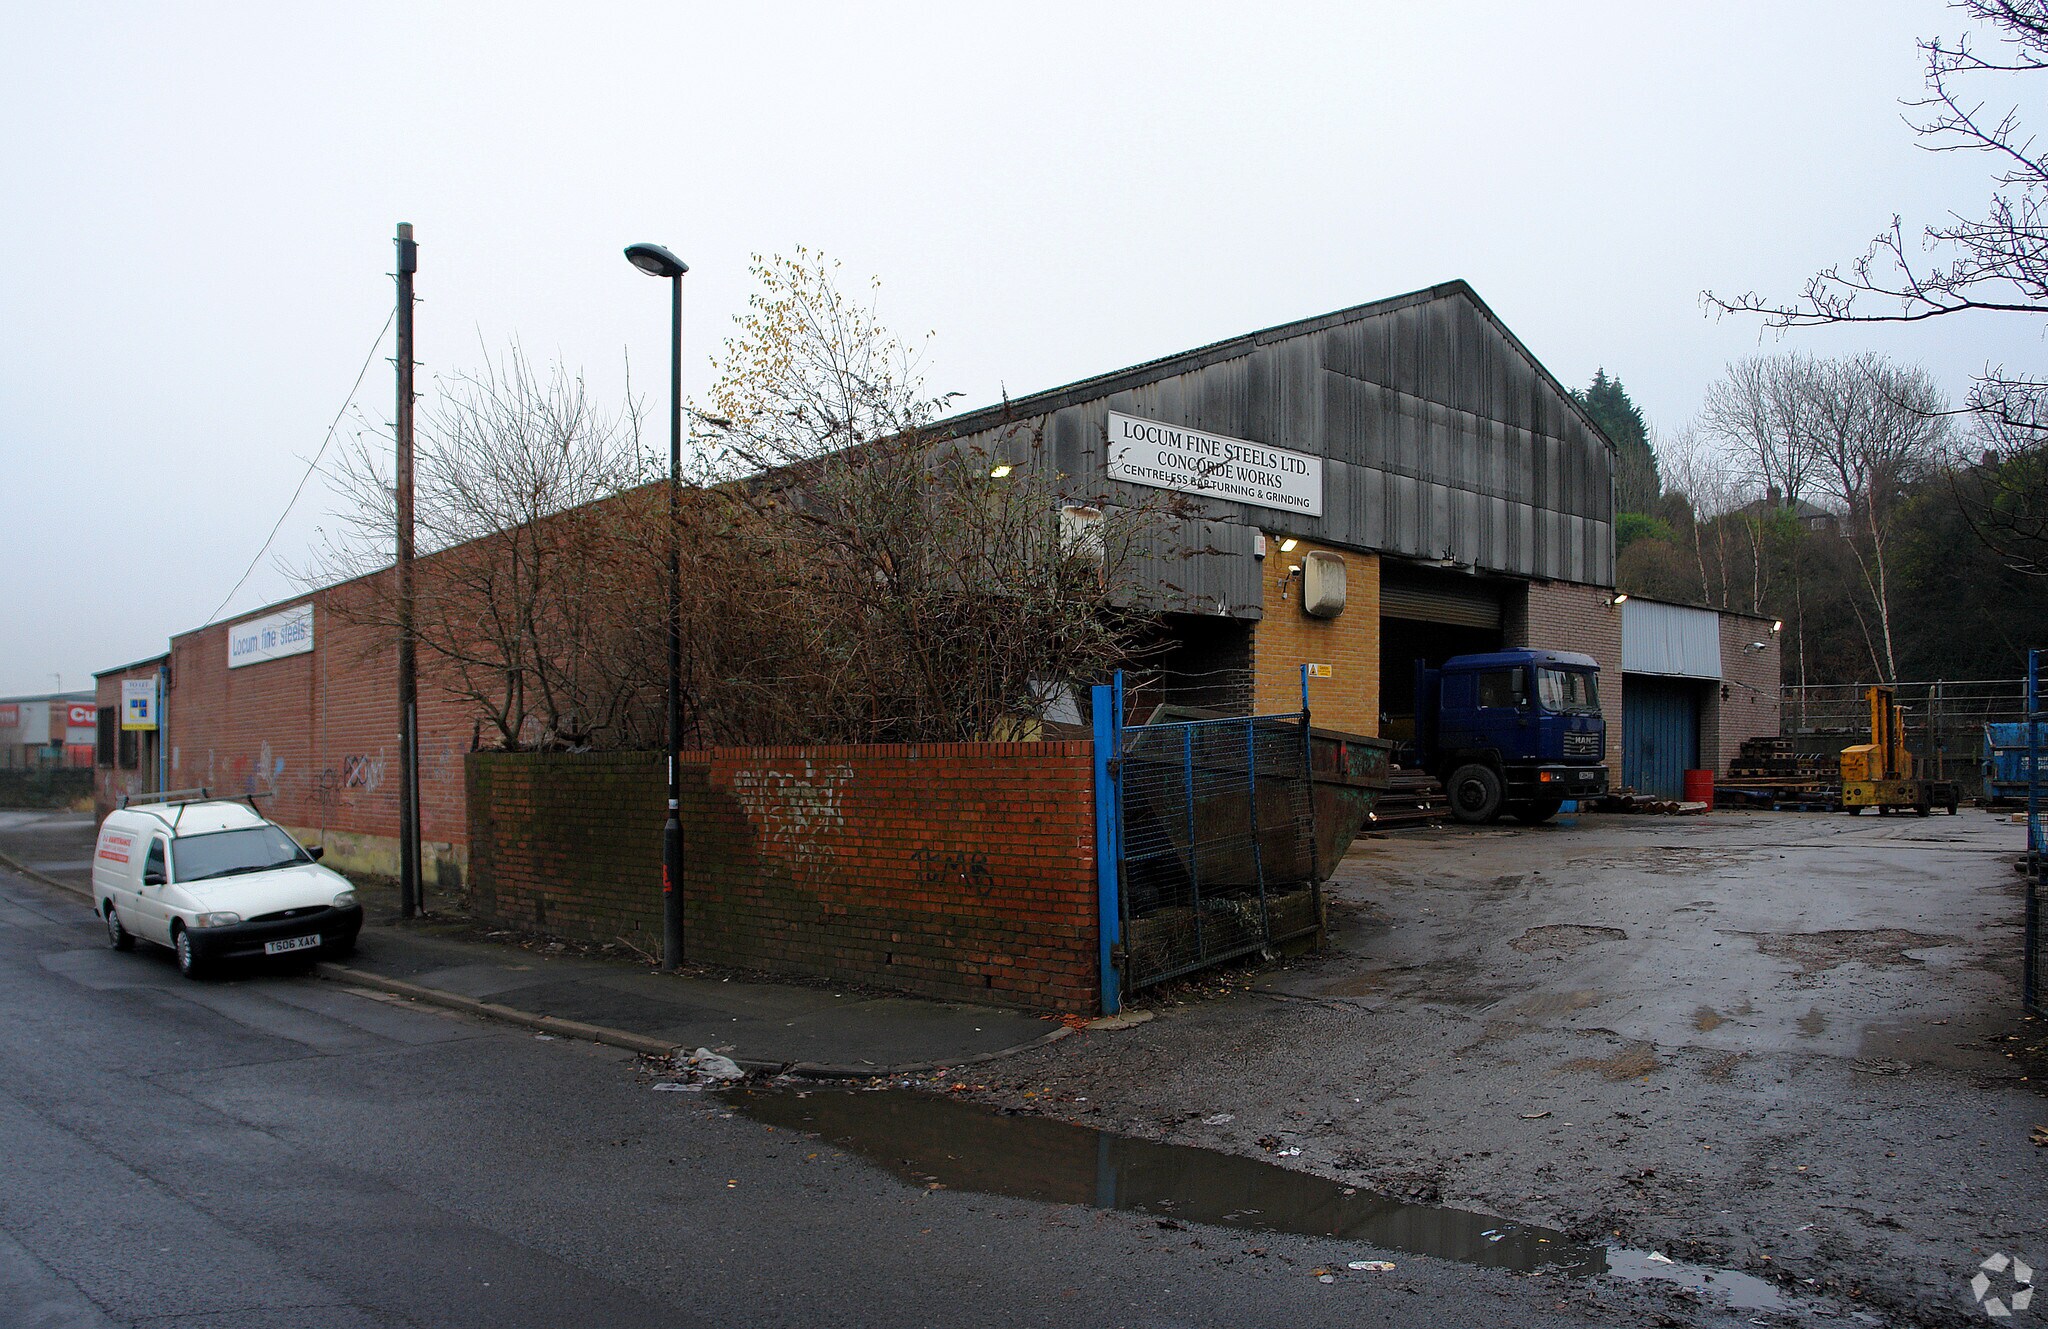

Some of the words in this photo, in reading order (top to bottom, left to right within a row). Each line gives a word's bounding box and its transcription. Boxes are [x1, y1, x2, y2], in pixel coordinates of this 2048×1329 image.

[1123, 421, 1182, 449] LOCUM
[1186, 435, 1221, 457] FINE
[1224, 443, 1278, 469] STEELS
[1280, 455, 1311, 476] LTD.
[1123, 464, 1188, 485] CENTRELESS
[1211, 481, 1255, 498] TURNING
[1257, 489, 1264, 499] &
[1265, 491, 1310, 508] GRINDING
[1157, 451, 1234, 479] CONCORDE
[1236, 466, 1282, 488] WORKS
[232, 633, 258, 657] Locum
[261, 627, 277, 650] fine
[280, 617, 305, 645] steels
[1575, 736, 1592, 744] MAN
[269, 940, 295, 952] T606
[297, 935, 316, 947] XAK
